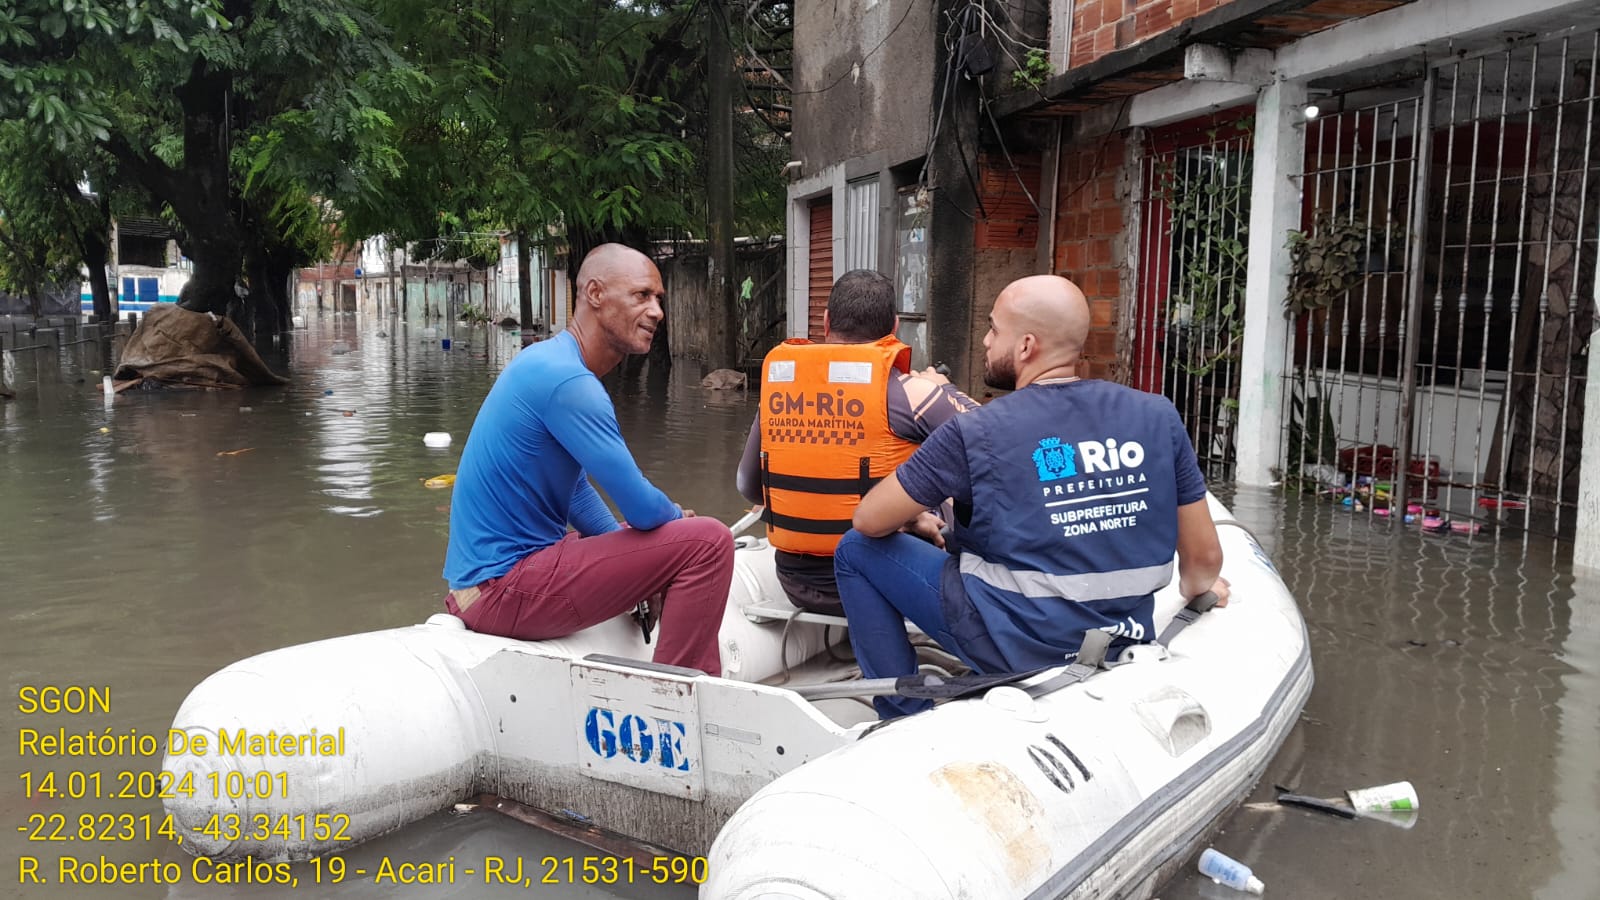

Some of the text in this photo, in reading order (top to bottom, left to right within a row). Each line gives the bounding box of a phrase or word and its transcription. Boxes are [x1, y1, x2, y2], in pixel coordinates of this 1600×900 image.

[768, 389, 865, 417] GM-Rio
[768, 416, 865, 430] GUARDA MARÍTIMA
[1078, 438, 1145, 474] Rio
[1042, 473, 1148, 497] PREFEITURA
[1050, 500, 1148, 526] SUBPREFEITURA
[1063, 516, 1137, 537] ZONA NORTE
